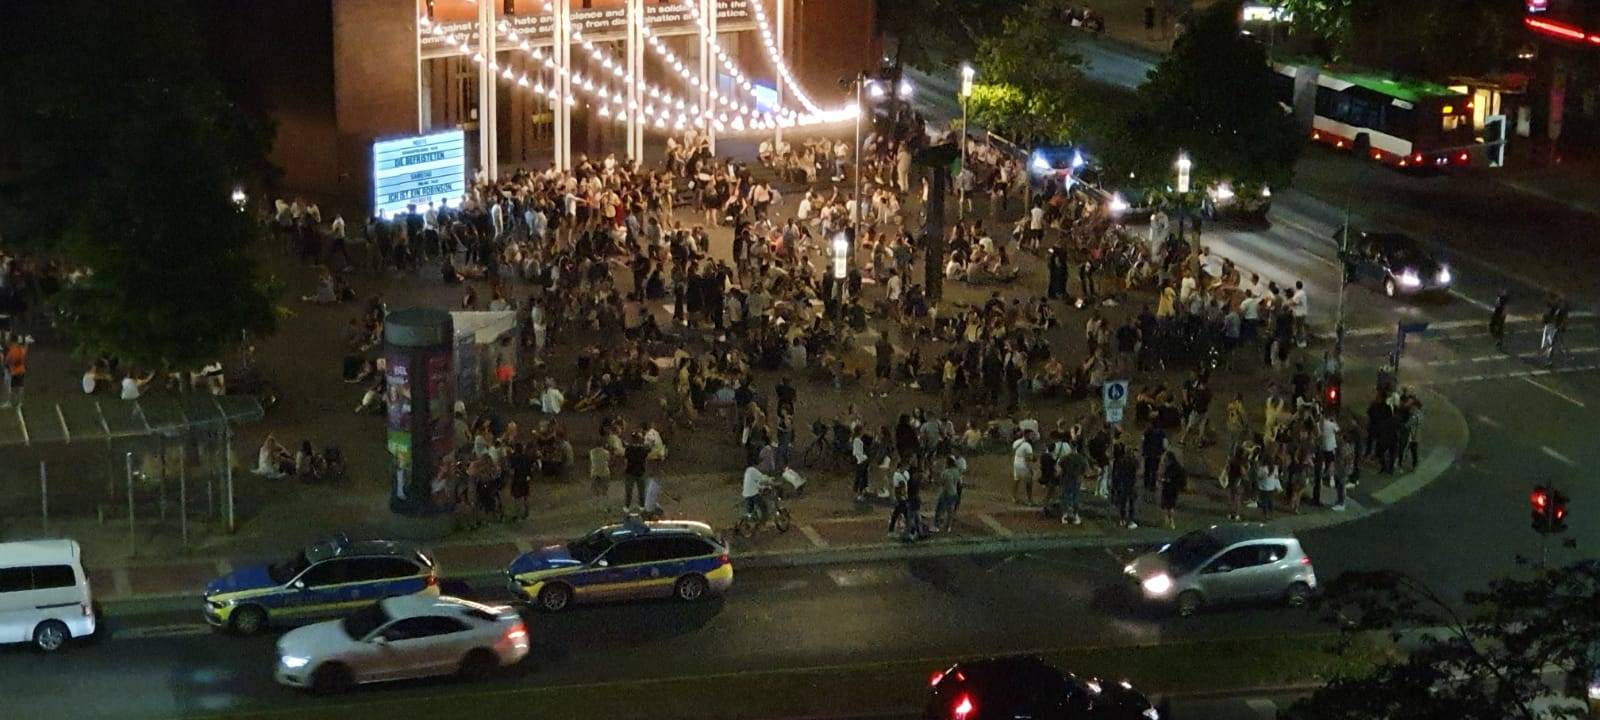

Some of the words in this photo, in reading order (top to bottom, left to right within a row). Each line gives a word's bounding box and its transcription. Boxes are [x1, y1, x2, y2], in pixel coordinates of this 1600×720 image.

[514, 16, 538, 25] hate
[540, 15, 554, 24] an
[569, 11, 603, 20] olence
[605, 8, 625, 17] and
[647, 5, 656, 14] in
[718, 1, 728, 9] th
[731, 0, 747, 9] the
[585, 19, 609, 28] from
[717, 9, 748, 18] ustice.
